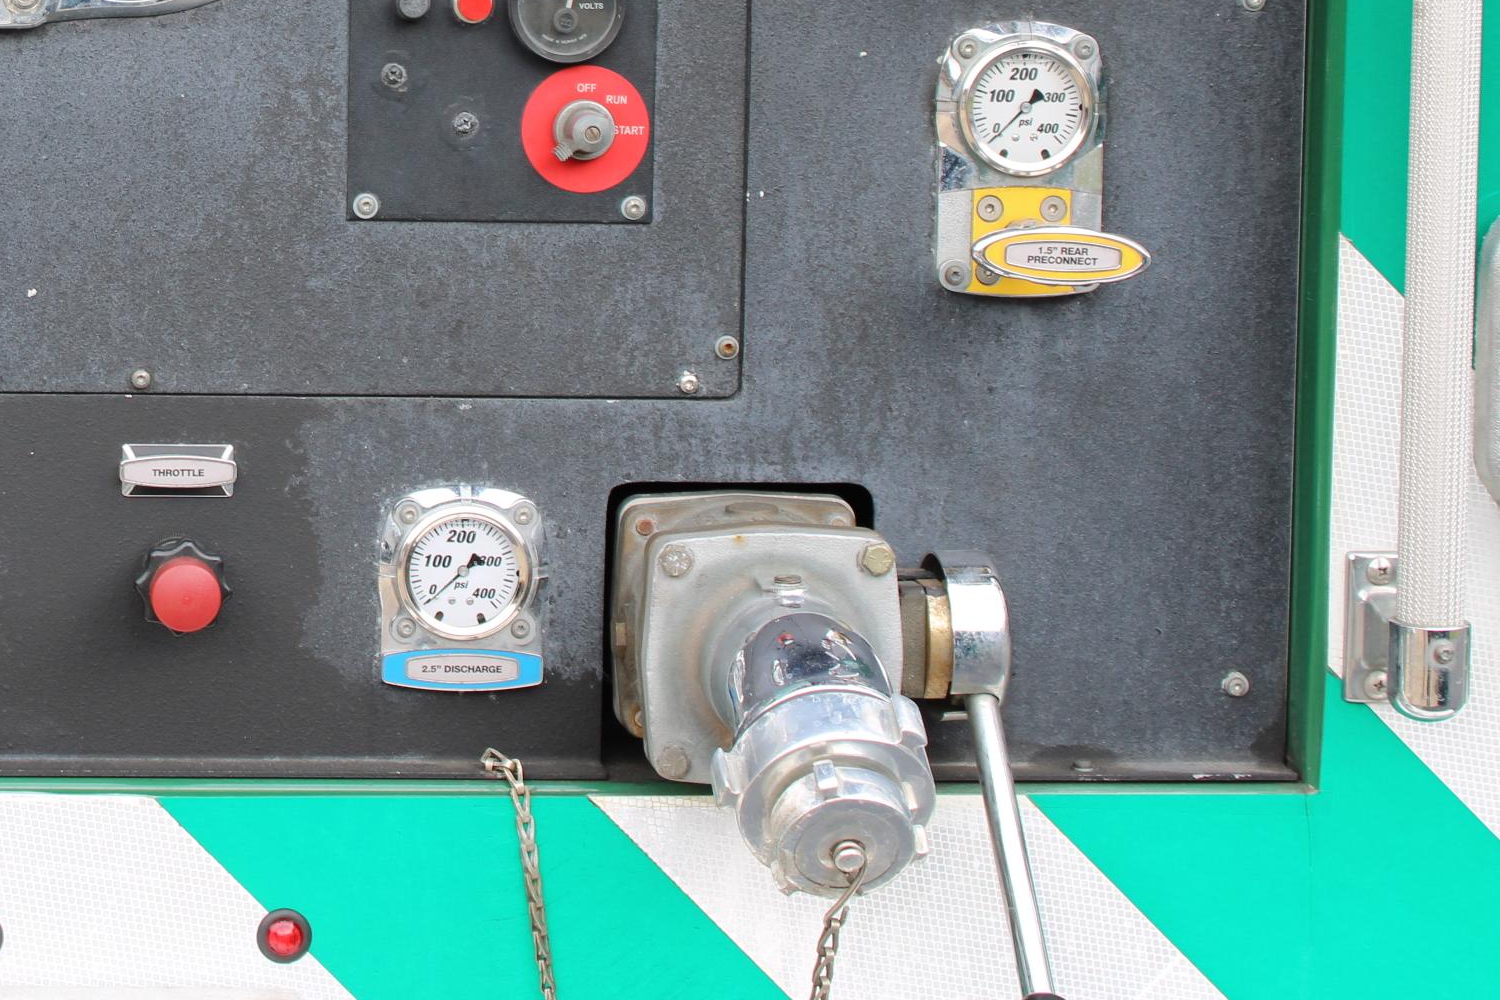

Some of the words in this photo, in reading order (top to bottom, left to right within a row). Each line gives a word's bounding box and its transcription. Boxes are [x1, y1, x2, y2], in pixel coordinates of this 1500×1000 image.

[579, 2, 604, 10] VOLTS
[1010, 68, 1038, 81] 200
[576, 84, 596, 92] OFF
[606, 95, 628, 104] RUN
[989, 89, 1015, 102] 100
[1043, 92, 1066, 103] 300
[1018, 118, 1034, 127] psi
[614, 126, 644, 136] START
[992, 122, 1000, 134] 0
[1036, 122, 1059, 134] 400
[1060, 247, 1089, 256] REAR
[1027, 256, 1098, 266] PRECONNECT
[152, 468, 204, 478] THROTTLE
[446, 529, 476, 544] 200
[424, 554, 452, 568] 100
[429, 584, 438, 594] 0
[454, 580, 469, 590] psi
[472, 588, 496, 599] 400
[444, 665, 503, 674] DISCHARGE
